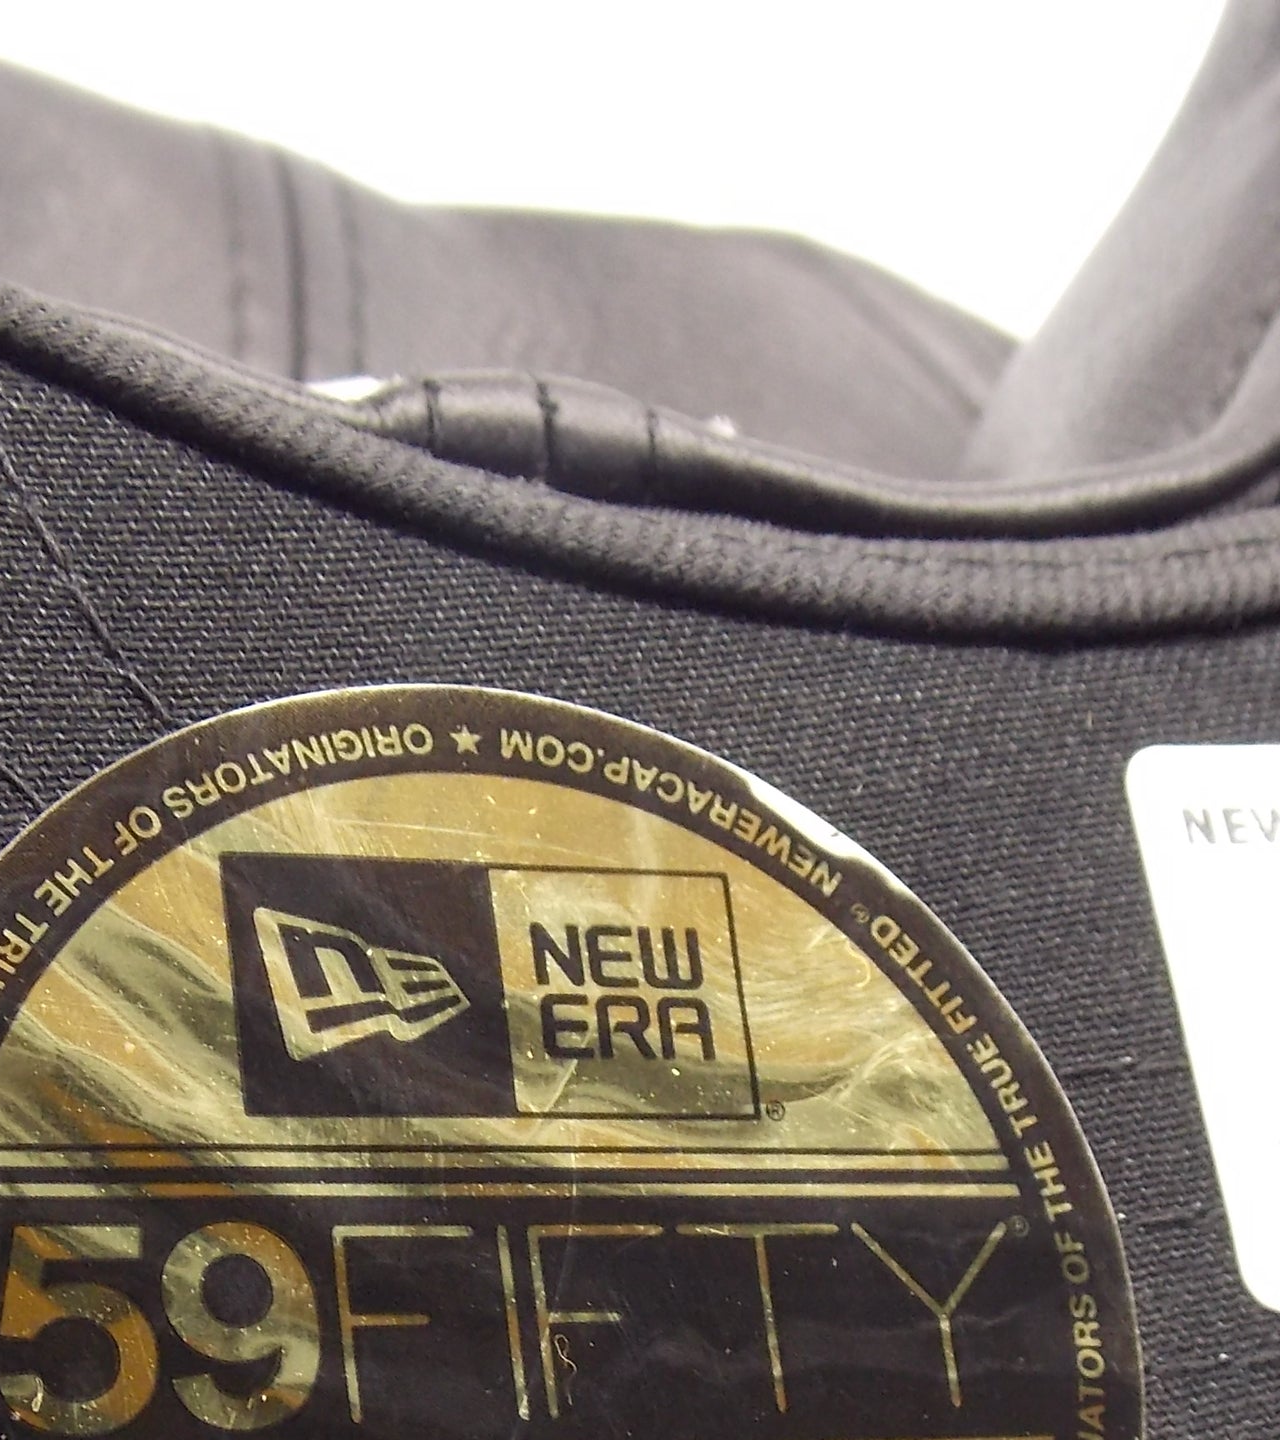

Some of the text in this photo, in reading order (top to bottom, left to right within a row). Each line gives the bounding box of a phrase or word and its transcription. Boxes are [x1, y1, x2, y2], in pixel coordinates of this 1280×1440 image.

[162, 722, 433, 818] ORIGINATORS
[114, 807, 162, 856] OF
[498, 726, 842, 897] NEWERACAP.COM
[33, 841, 115, 917] THE
[528, 922, 704, 990] NEW
[540, 993, 717, 1062] ERA
[964, 1040, 1040, 1139] TRUE
[1023, 1140, 1074, 1223] THE
[1053, 1231, 1090, 1284] OF
